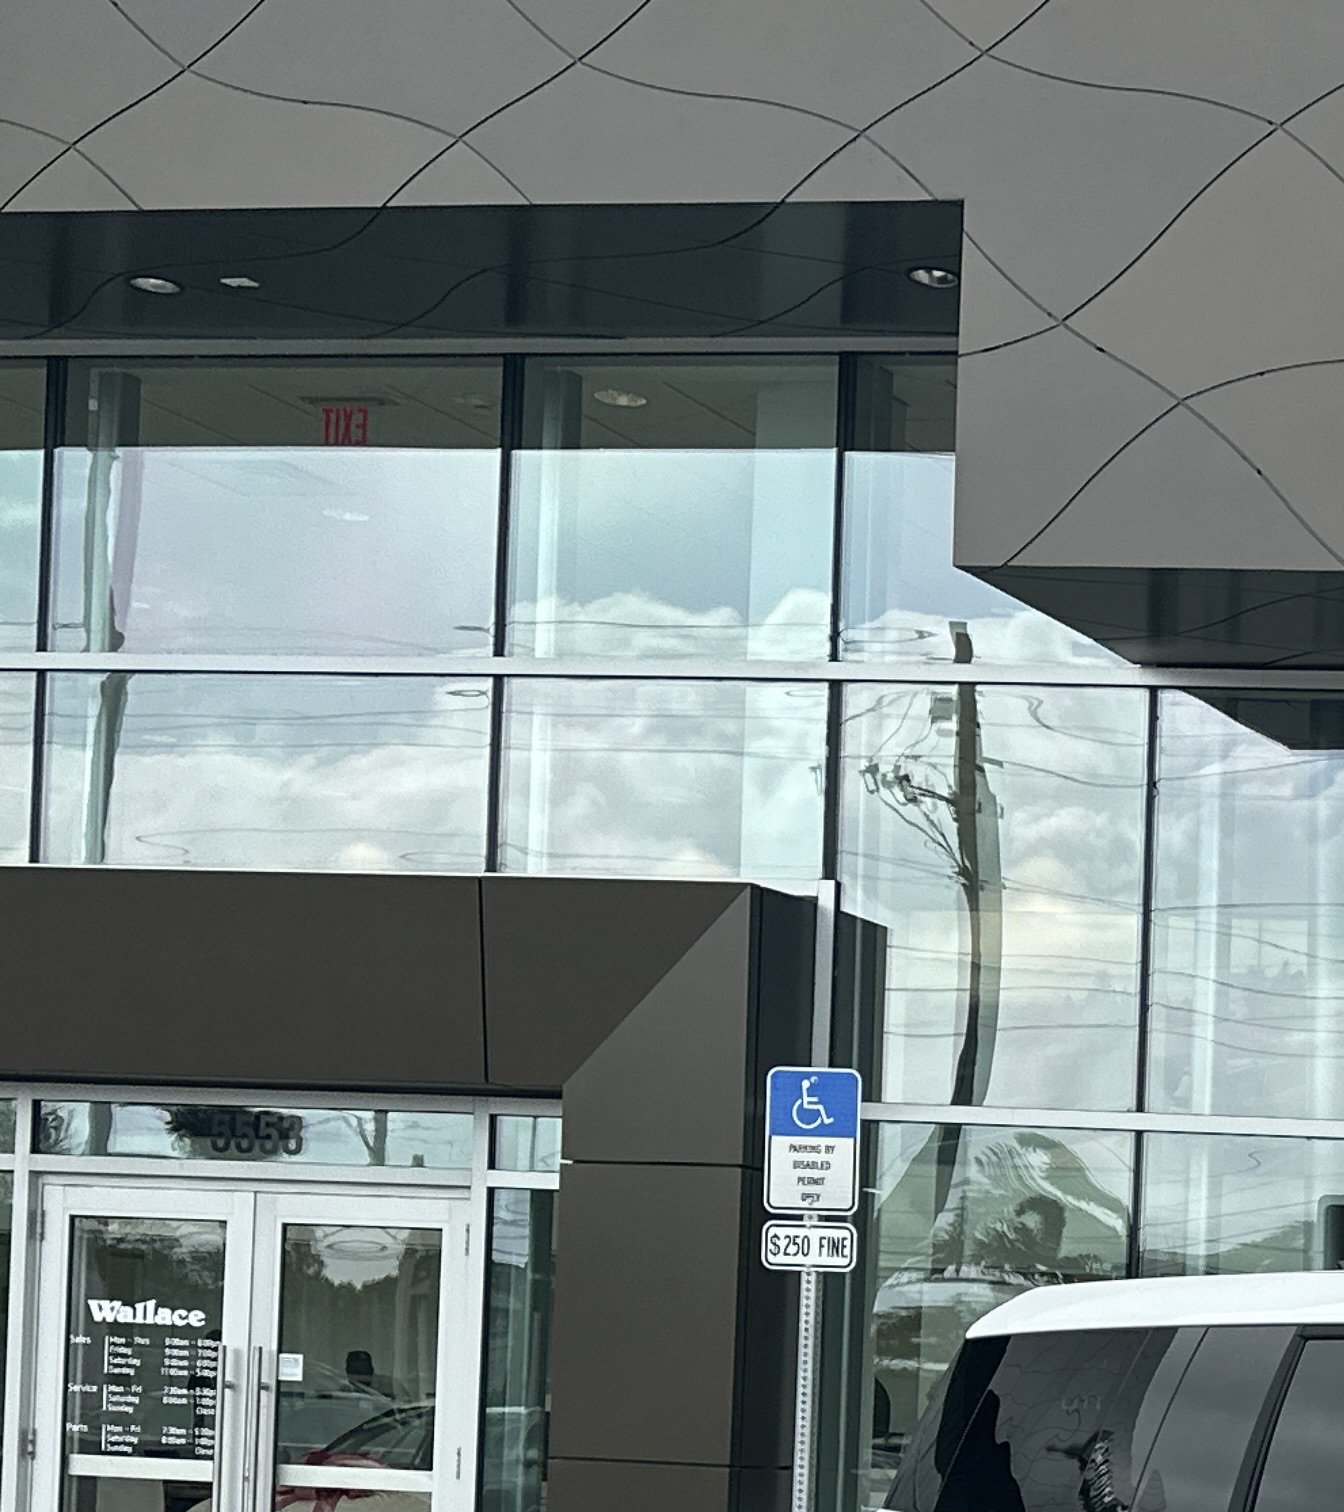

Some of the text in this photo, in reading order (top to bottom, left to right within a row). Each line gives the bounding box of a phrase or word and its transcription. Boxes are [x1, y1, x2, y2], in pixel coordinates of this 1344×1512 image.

[210, 1111, 303, 1155] 5553
[789, 1144, 836, 1154] PARKING BY
[793, 1160, 831, 1170] DISABLED
[797, 1176, 825, 1186] PERMIT
[769, 1233, 848, 1258] $250 FINE
[87, 1299, 206, 1327] Wallace
[68, 1382, 99, 1392] Service
